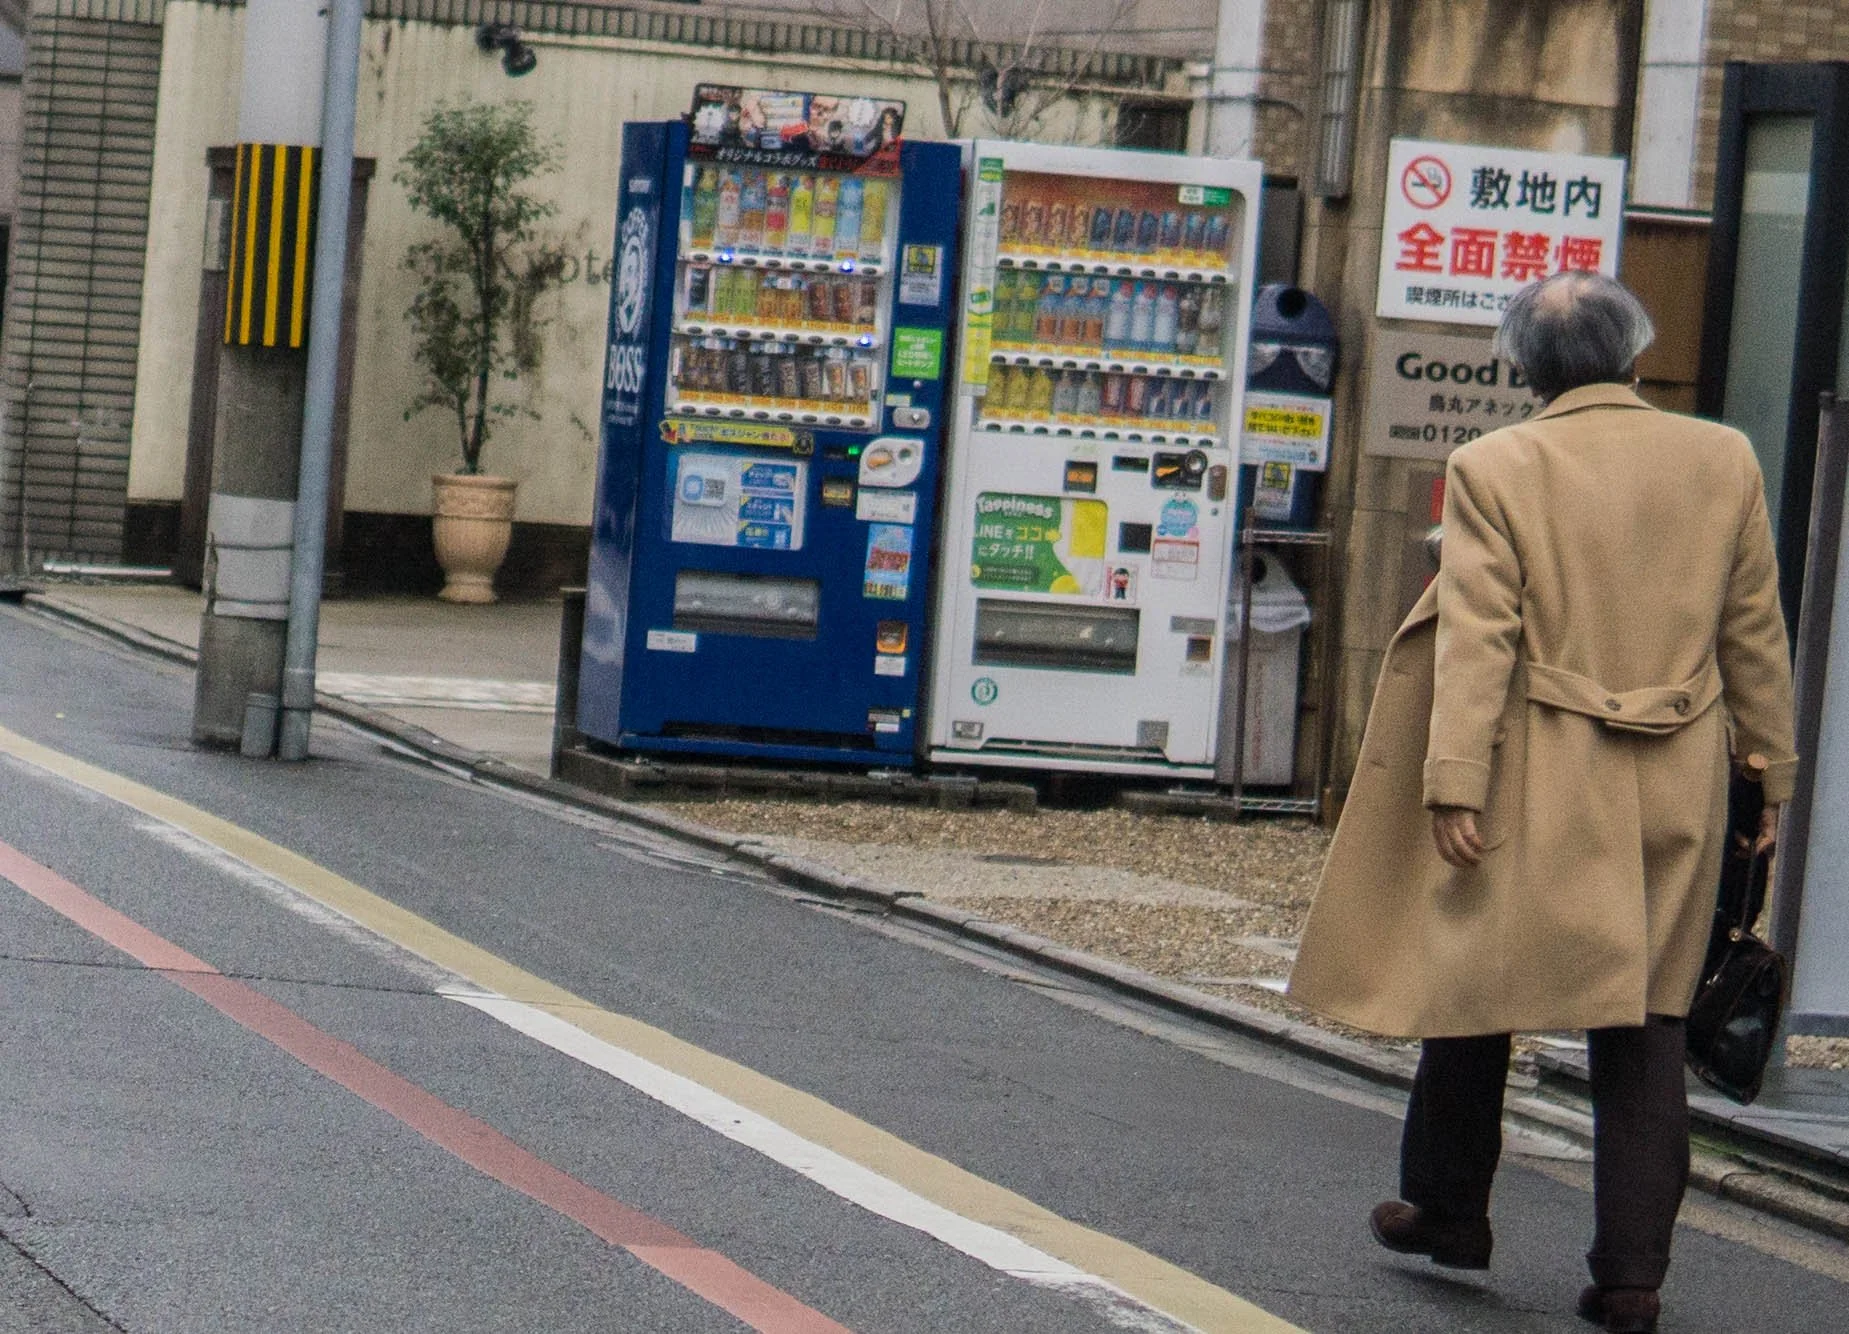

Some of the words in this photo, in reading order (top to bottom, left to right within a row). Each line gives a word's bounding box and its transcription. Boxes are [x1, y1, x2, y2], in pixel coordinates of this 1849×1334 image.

[1470, 166, 1602, 219] 敷地内
[1394, 222, 1602, 282] 全面禁煙
[607, 344, 643, 394] BOSS
[1396, 352, 1499, 386] Good
